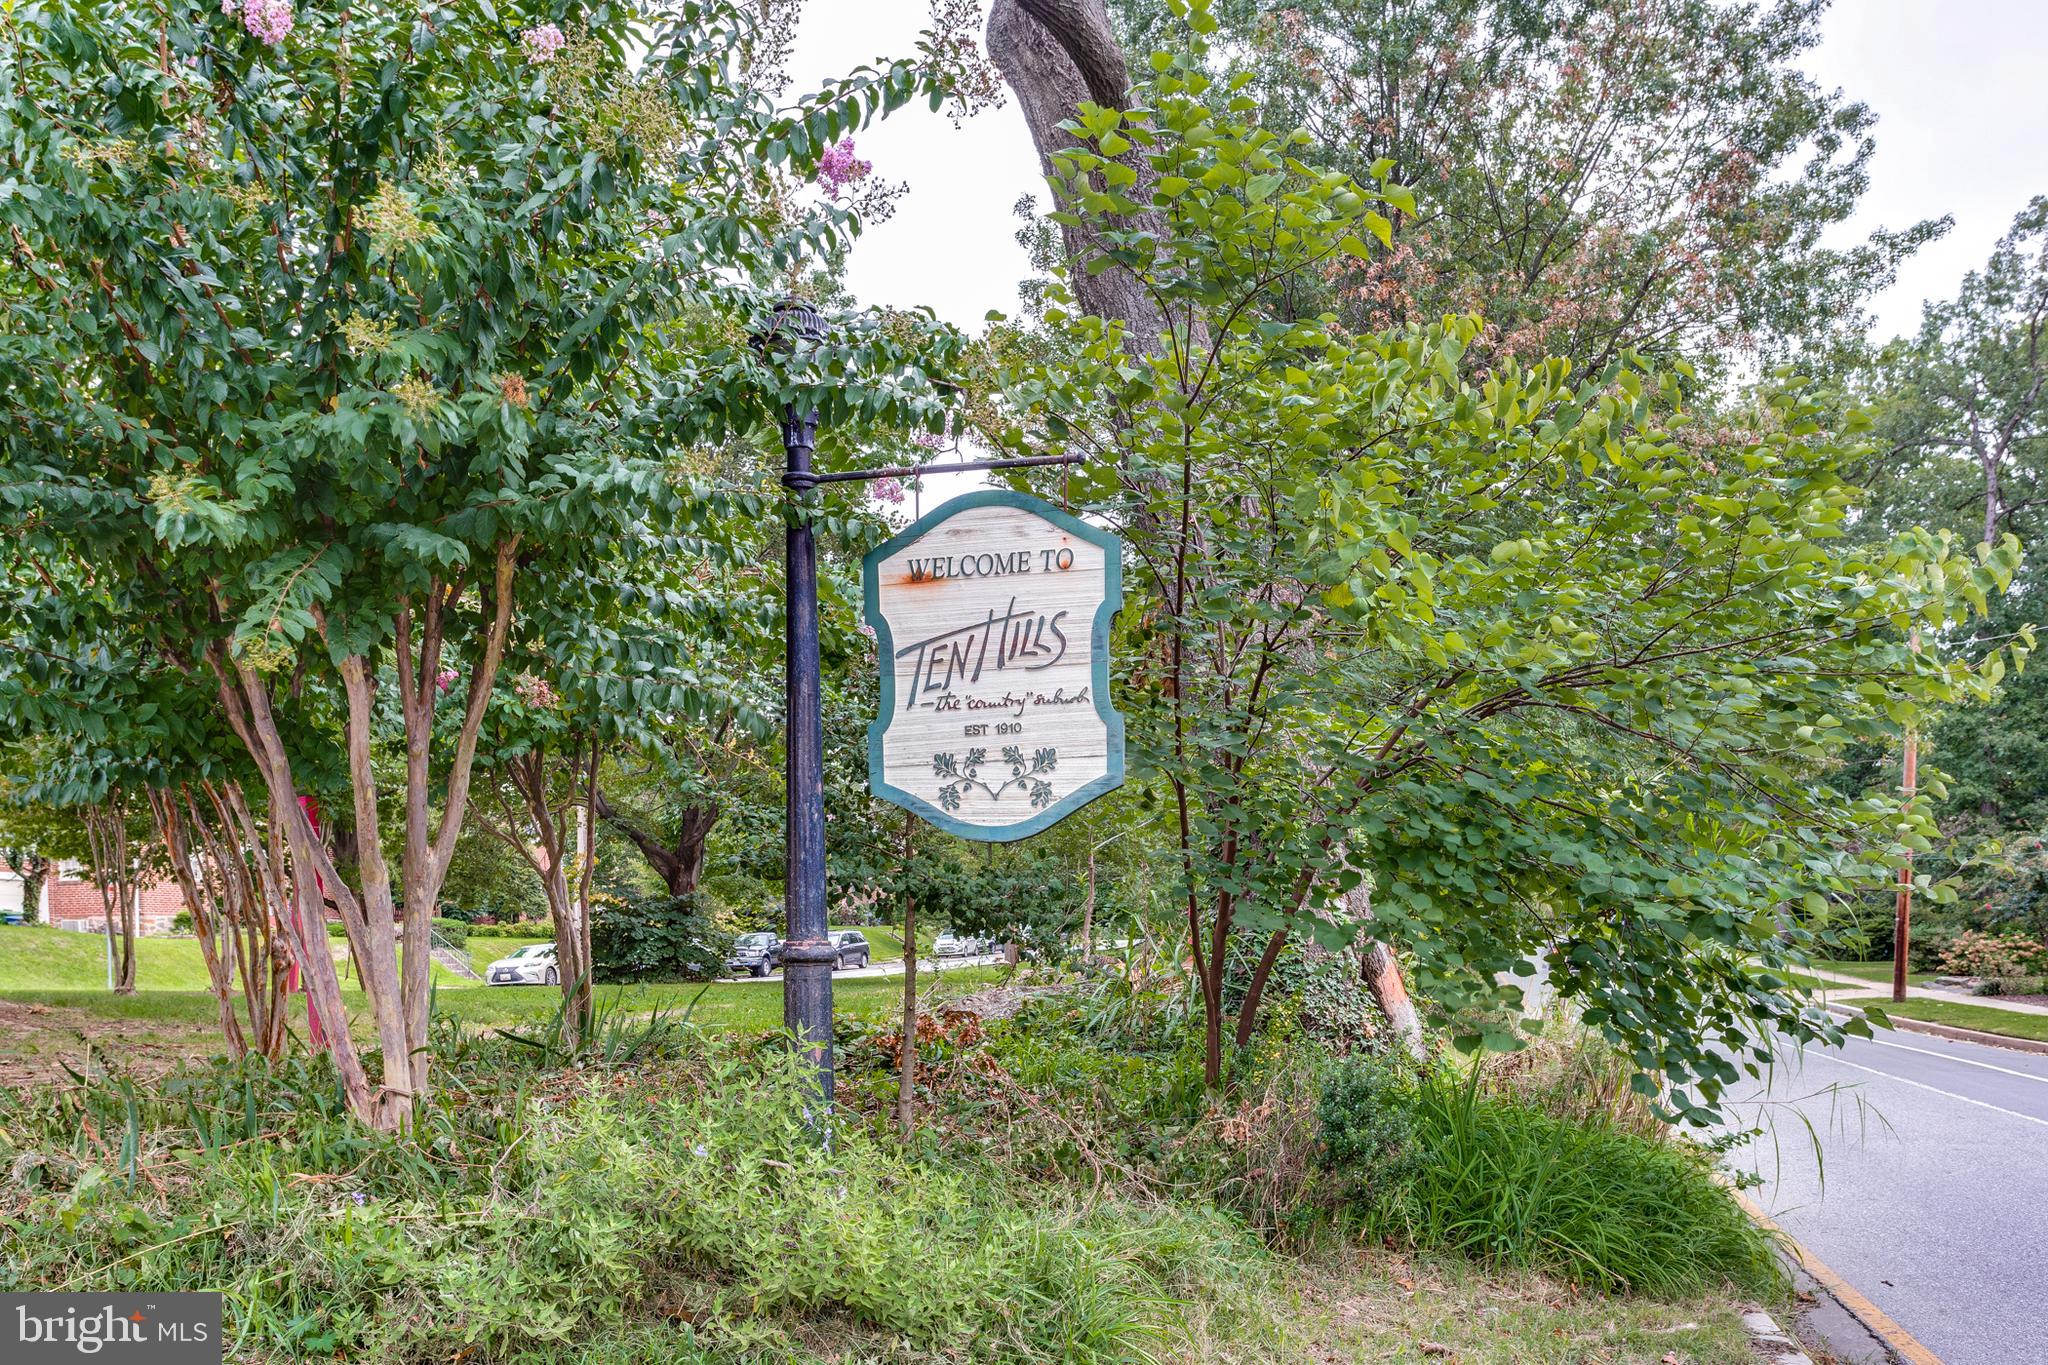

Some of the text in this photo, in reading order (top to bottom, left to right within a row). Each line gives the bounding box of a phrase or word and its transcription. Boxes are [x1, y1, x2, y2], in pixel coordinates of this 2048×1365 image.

[907, 547, 1074, 582] WELCOME TO
[896, 596, 1069, 711] TEN HILLS
[1033, 686, 1090, 705] suburb
[964, 722, 1022, 736] EST 1910
